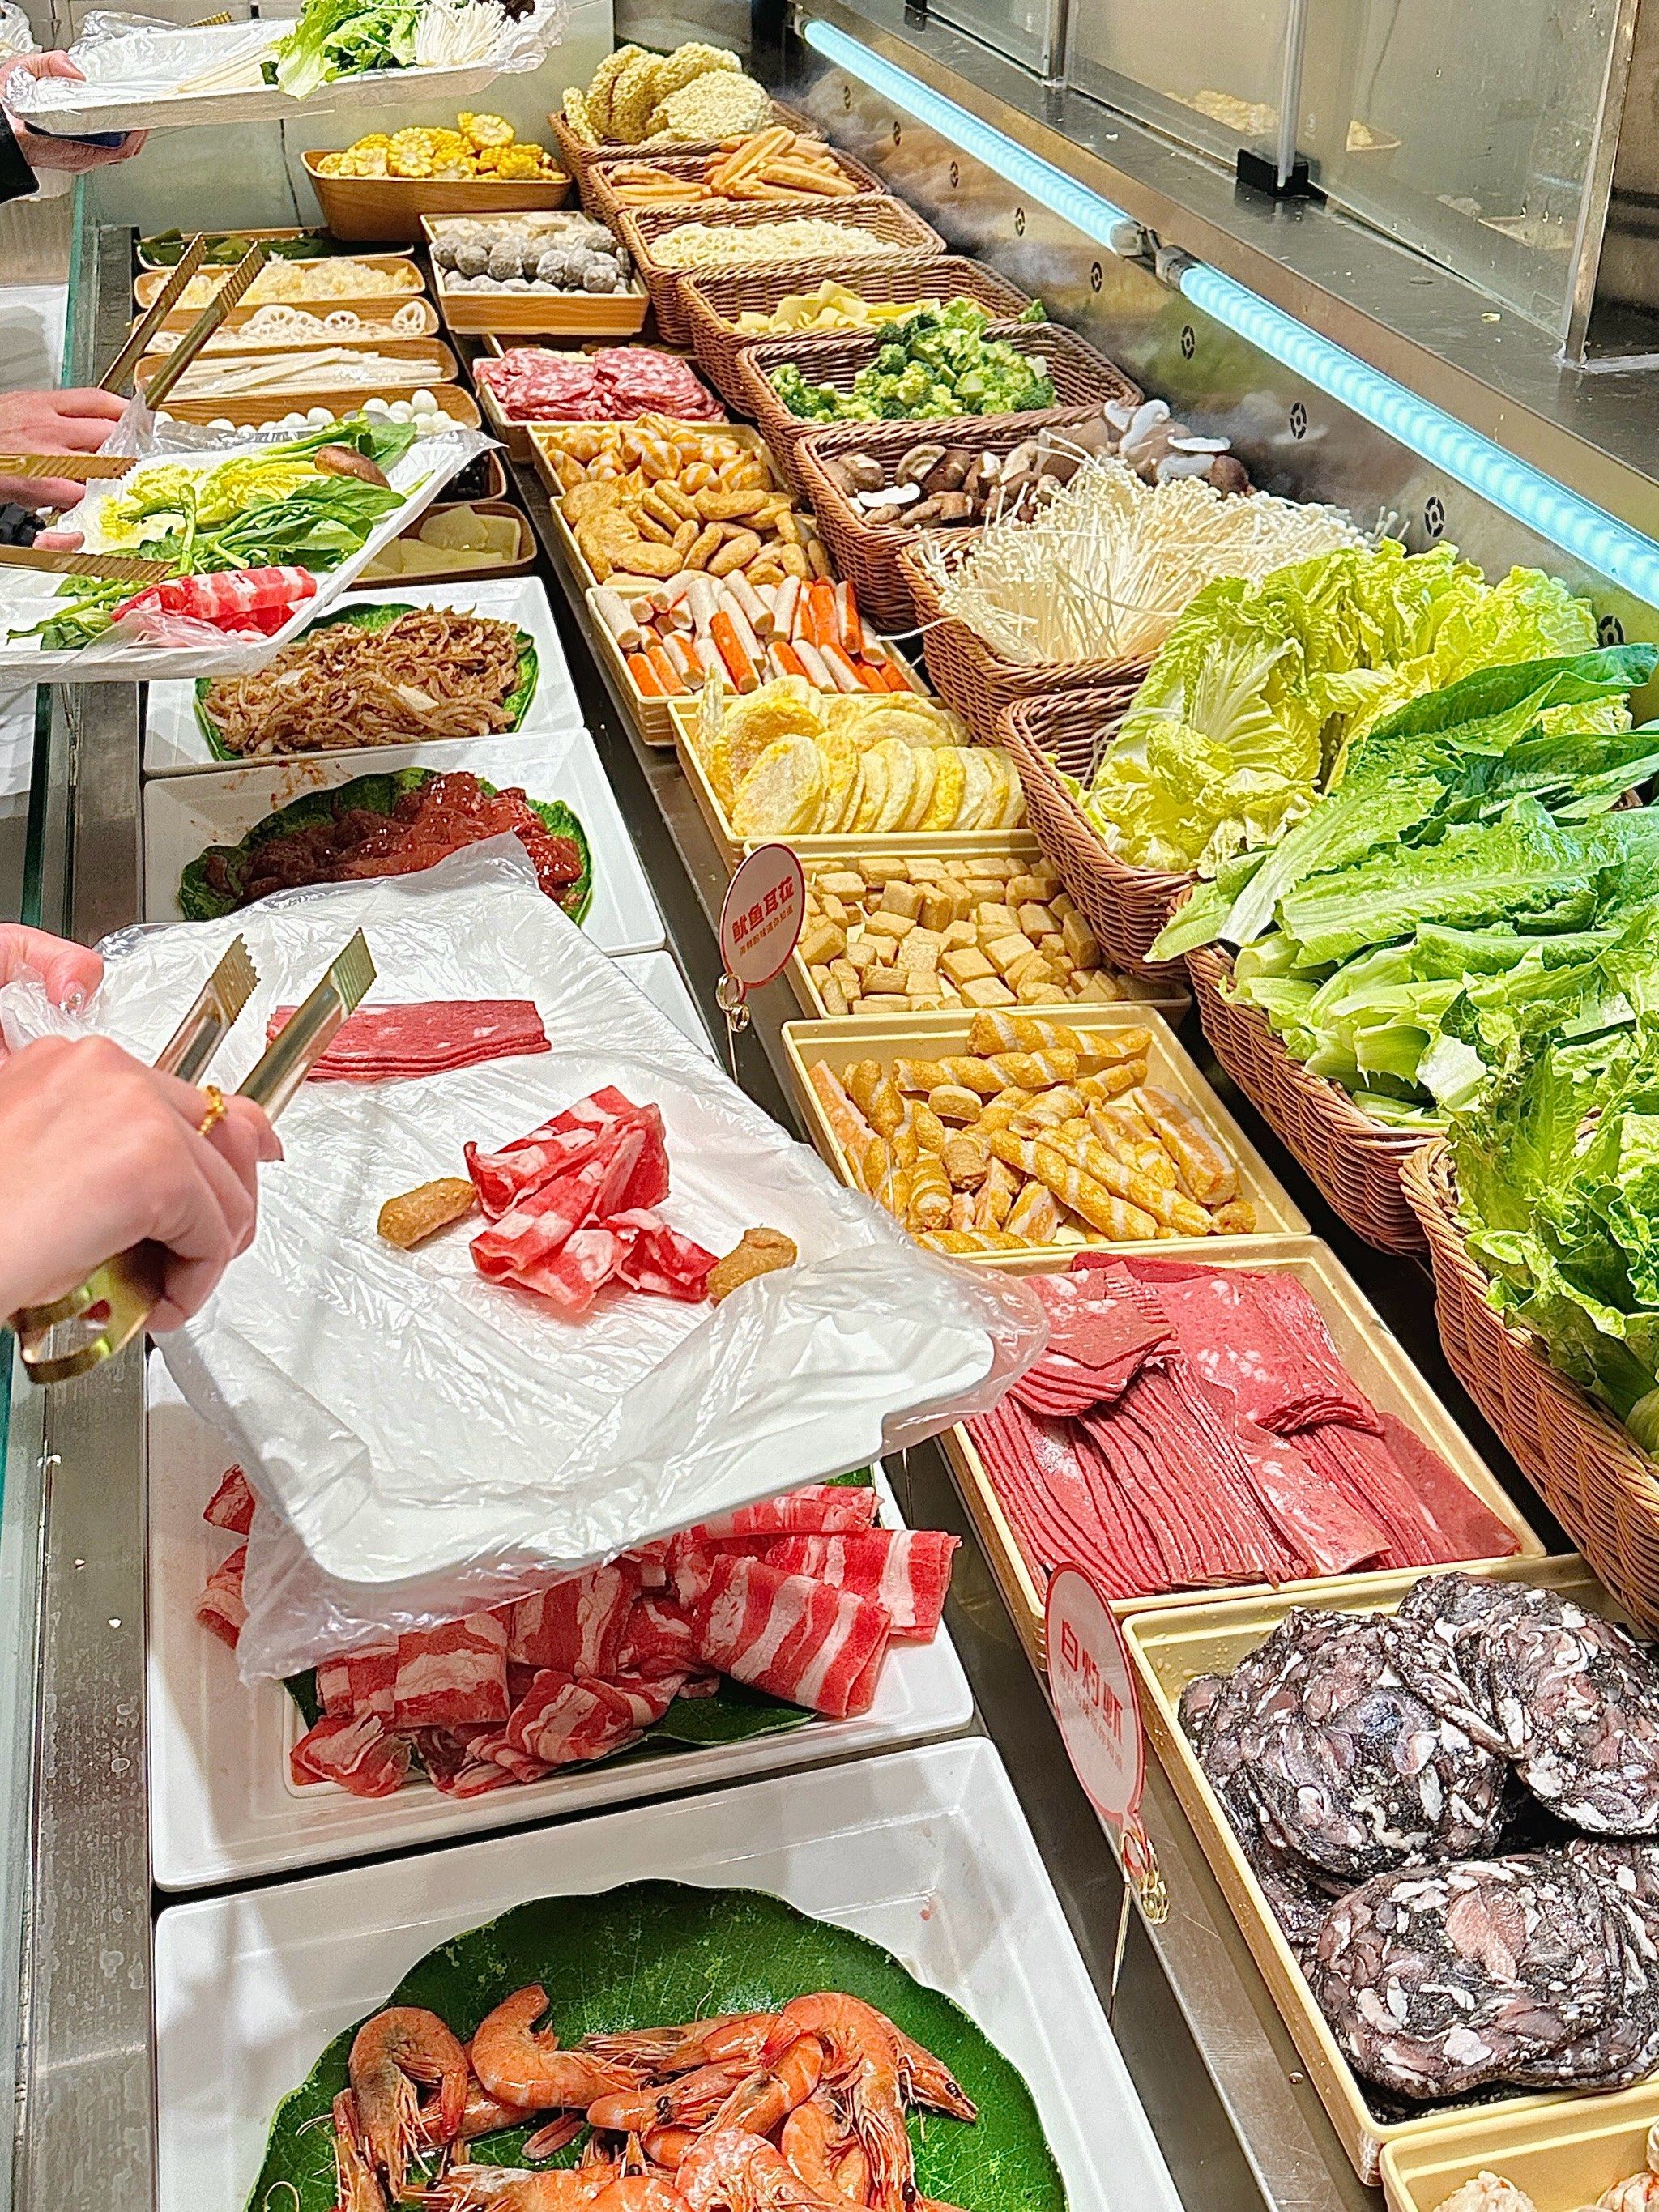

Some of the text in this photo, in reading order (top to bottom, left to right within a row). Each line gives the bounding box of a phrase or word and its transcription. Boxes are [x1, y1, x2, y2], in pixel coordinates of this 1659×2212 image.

[731, 875, 794, 944] 鱿鱼耳花
[1062, 1619, 1123, 1745] 白灼虾
